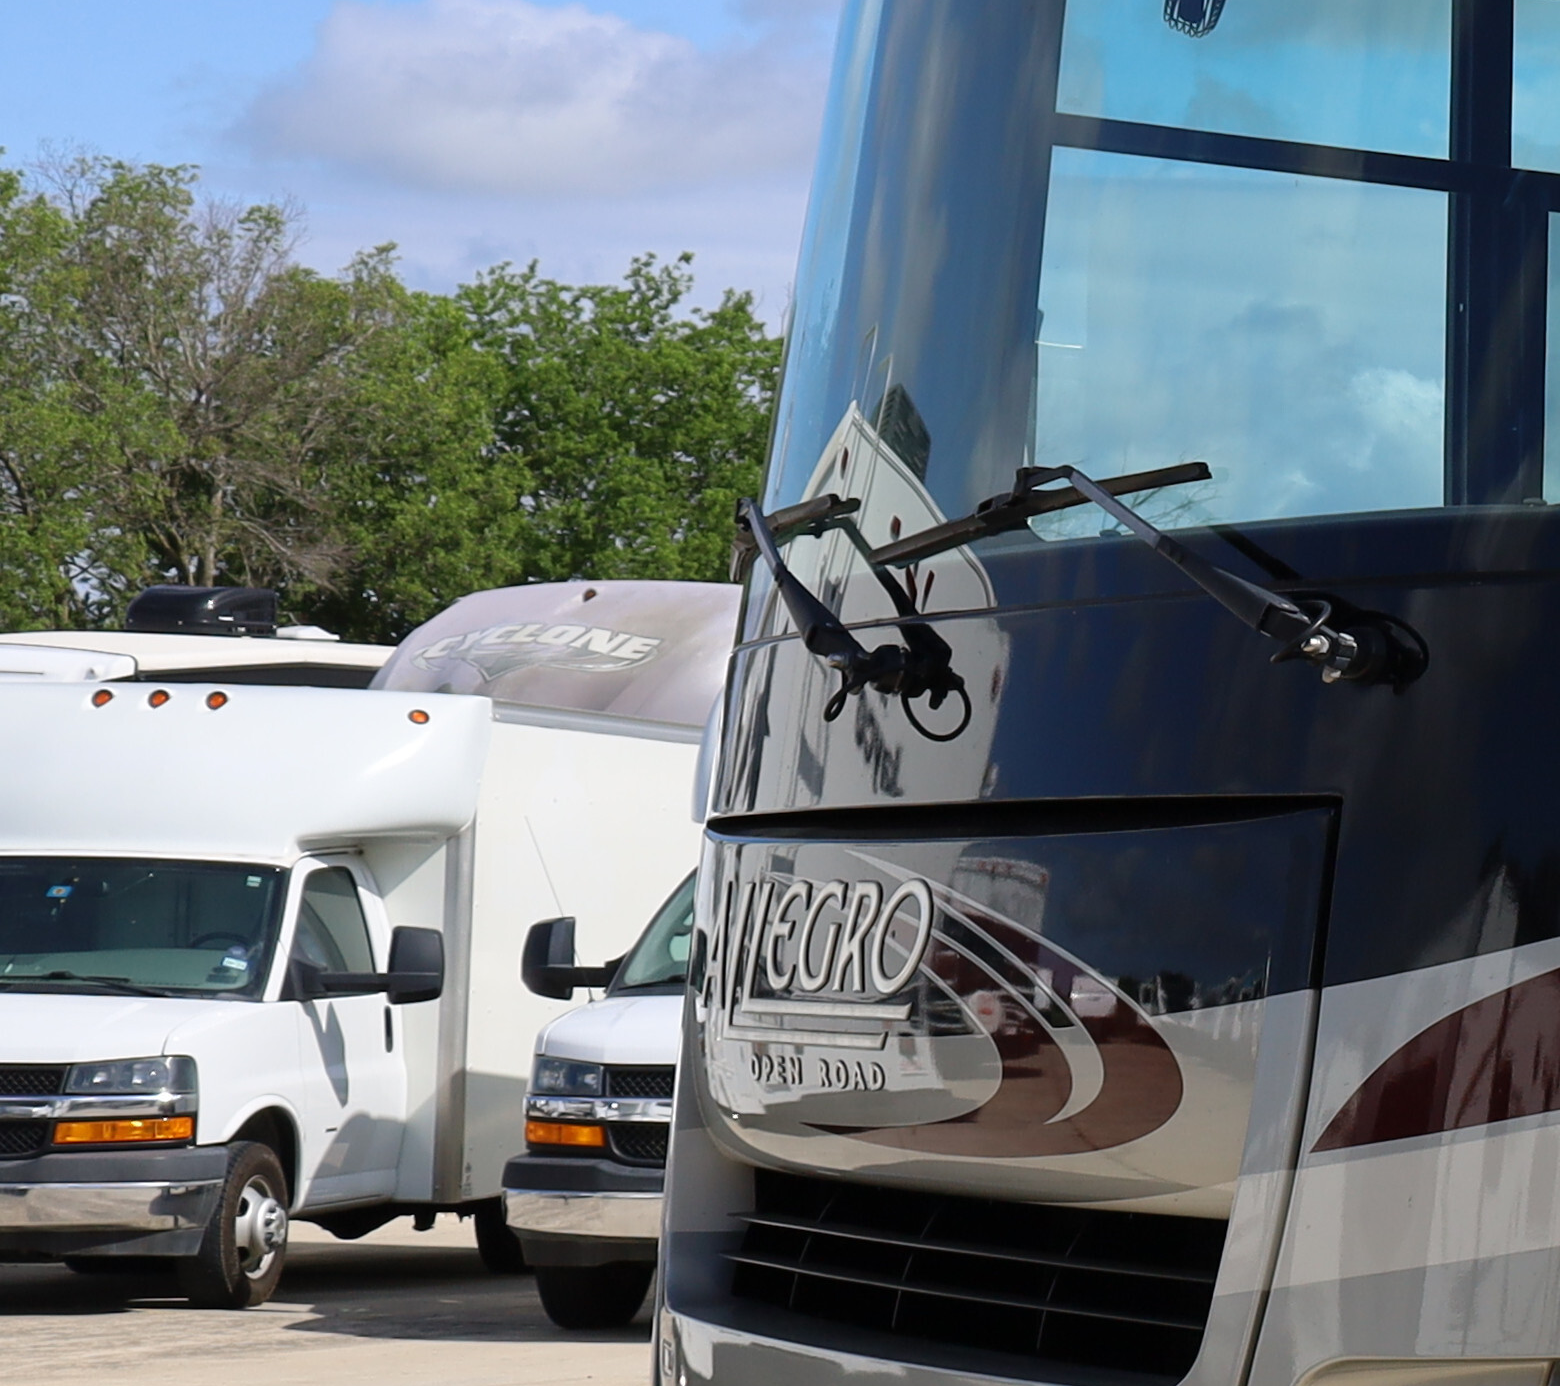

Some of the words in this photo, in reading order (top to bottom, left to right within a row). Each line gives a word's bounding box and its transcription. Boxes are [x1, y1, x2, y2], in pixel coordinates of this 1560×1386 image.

[421, 622, 662, 662] CYCLONE
[701, 877, 935, 1051] ALLEGRO
[751, 1053, 804, 1085] OPEN
[818, 1057, 886, 1092] ROAD
